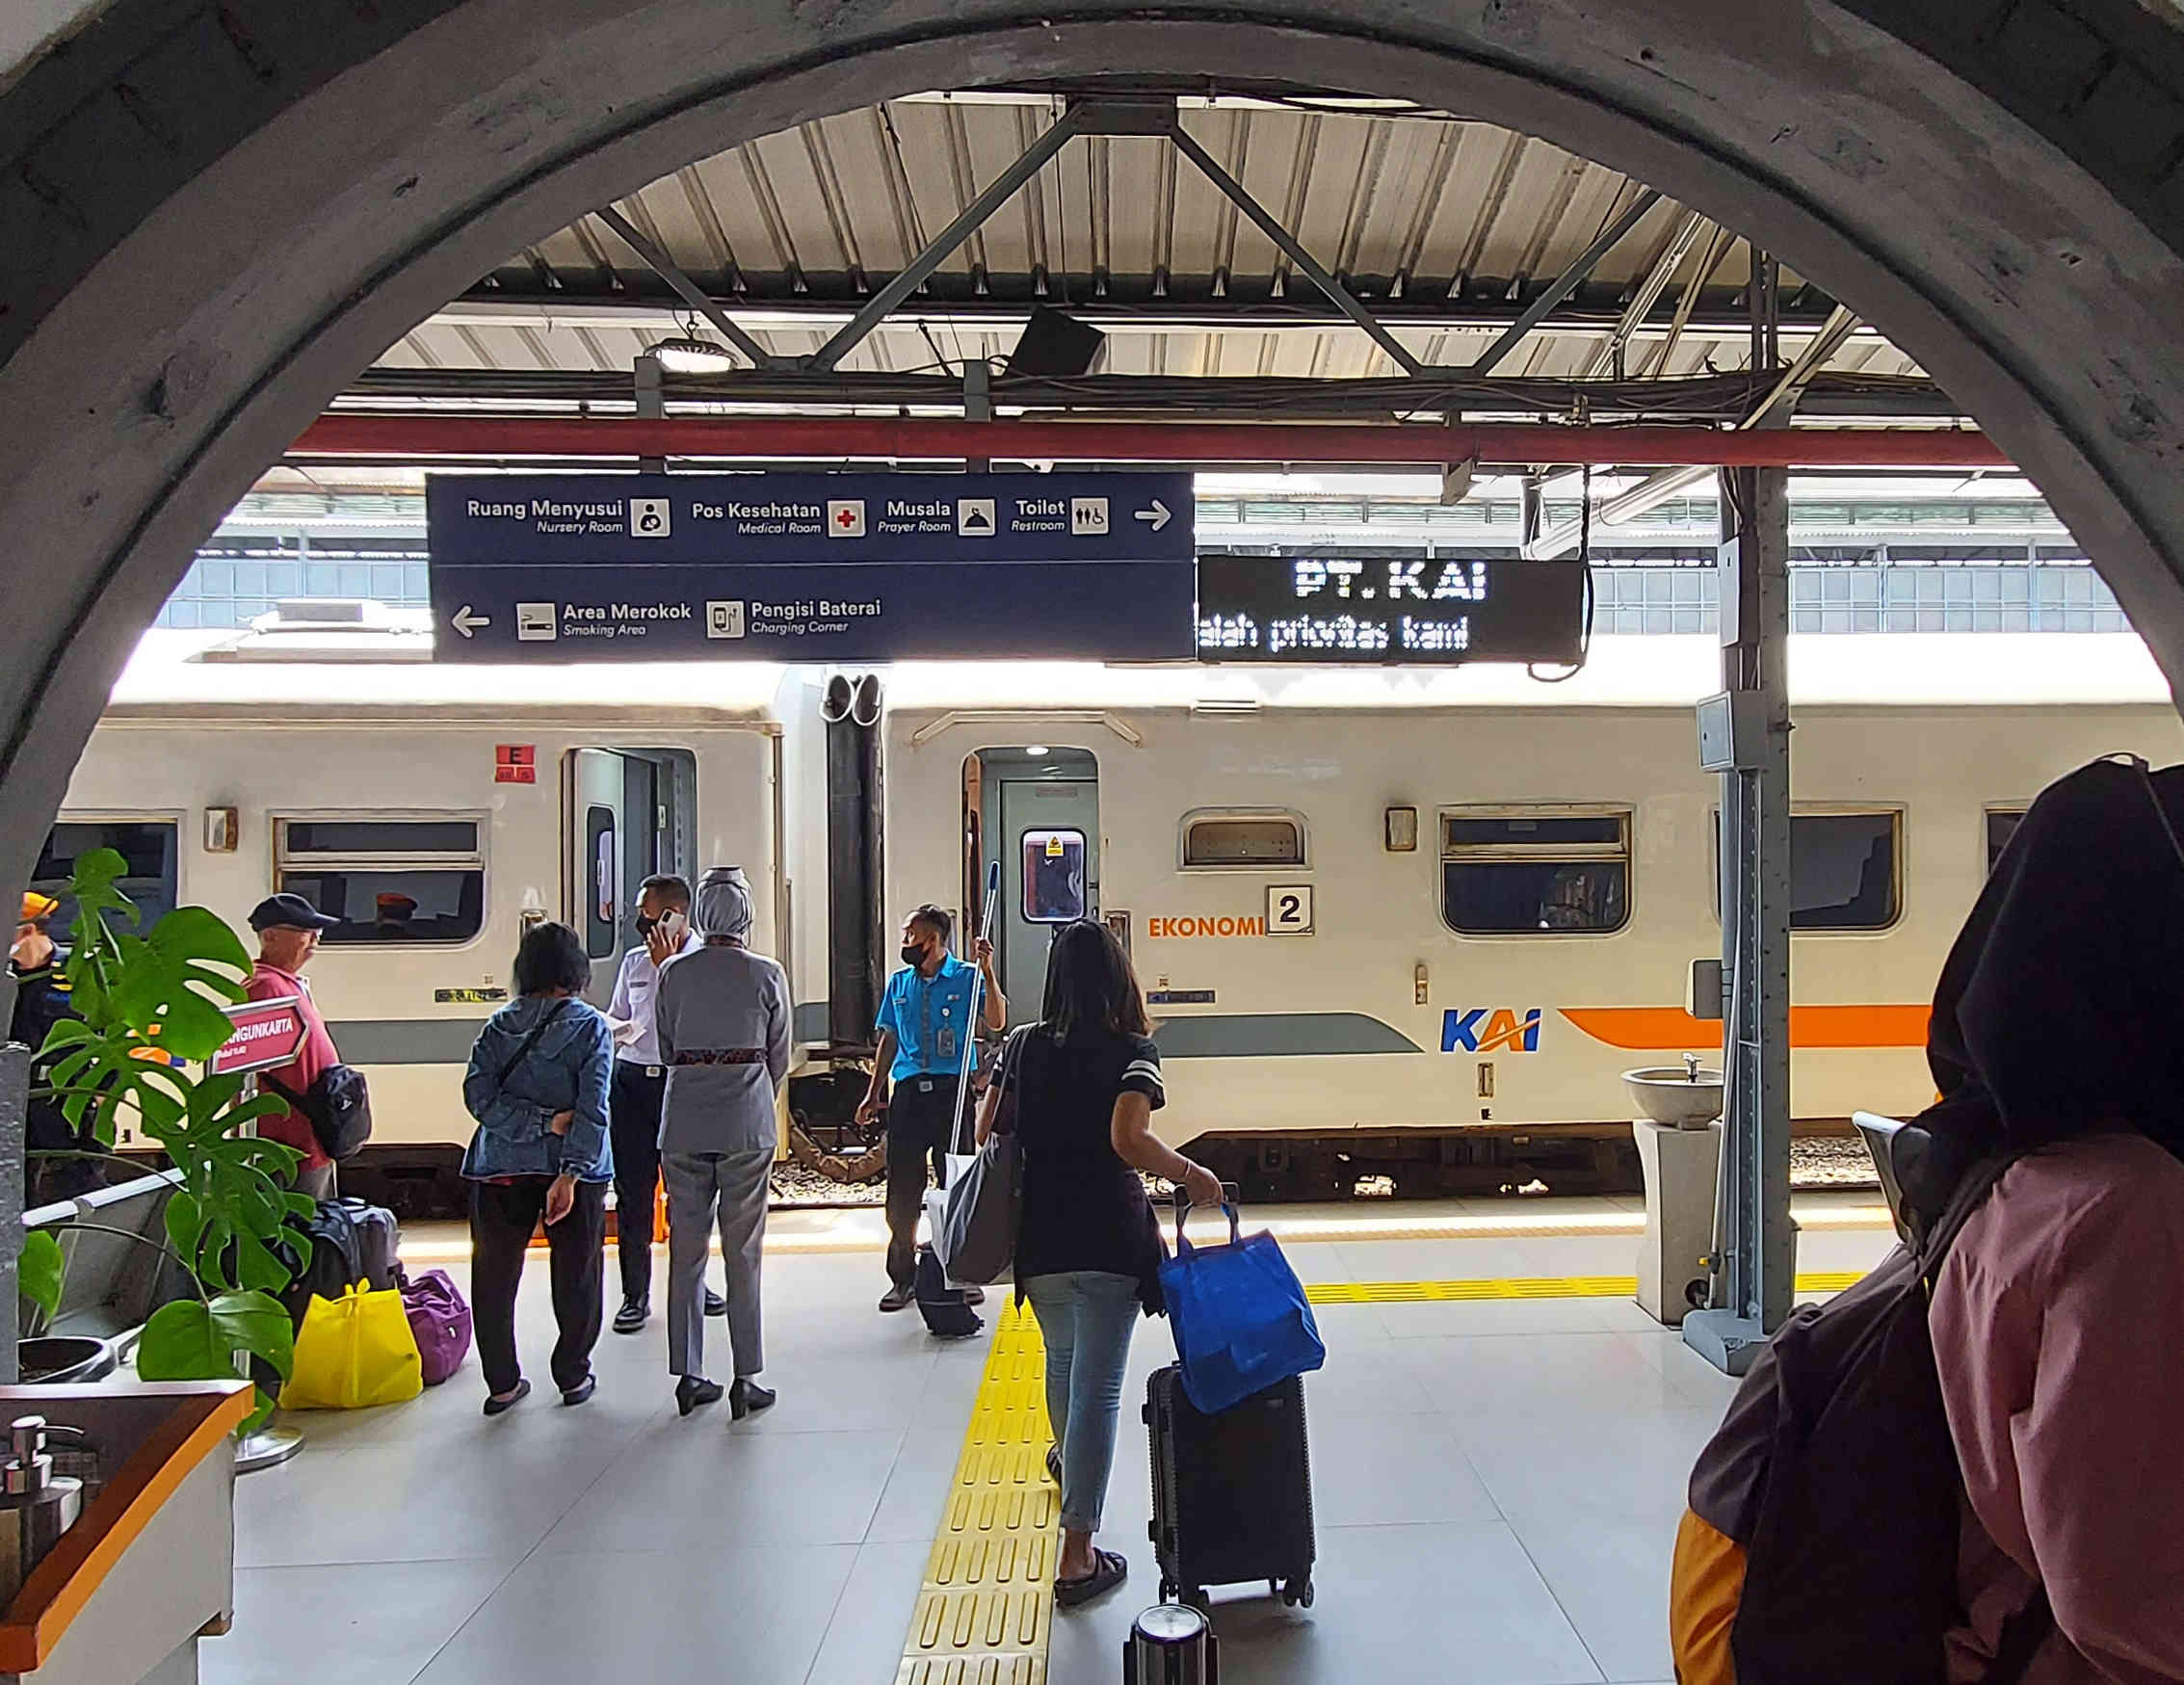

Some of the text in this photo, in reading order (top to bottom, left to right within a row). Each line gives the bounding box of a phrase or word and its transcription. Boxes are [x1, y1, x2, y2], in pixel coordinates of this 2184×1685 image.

[468, 499, 622, 519] Ruang Menyusui
[693, 502, 821, 518] Pos Kesehatan
[887, 500, 951, 516] Musala
[1016, 499, 1066, 515] Toilet
[537, 520, 623, 534] Nursery Room
[738, 522, 821, 534] Medical Room
[878, 521, 951, 534] Prayer Room
[1012, 519, 1065, 532] Restroom
[563, 602, 692, 619] Area Merokok
[751, 599, 881, 620] Pengisi Baterai
[563, 623, 646, 638] Smoking Area
[751, 620, 849, 637] Charging Corner
[510, 747, 525, 764] E
[1148, 895, 1302, 937] EKONOMI 2
[1442, 1009, 1541, 1052] KAI
